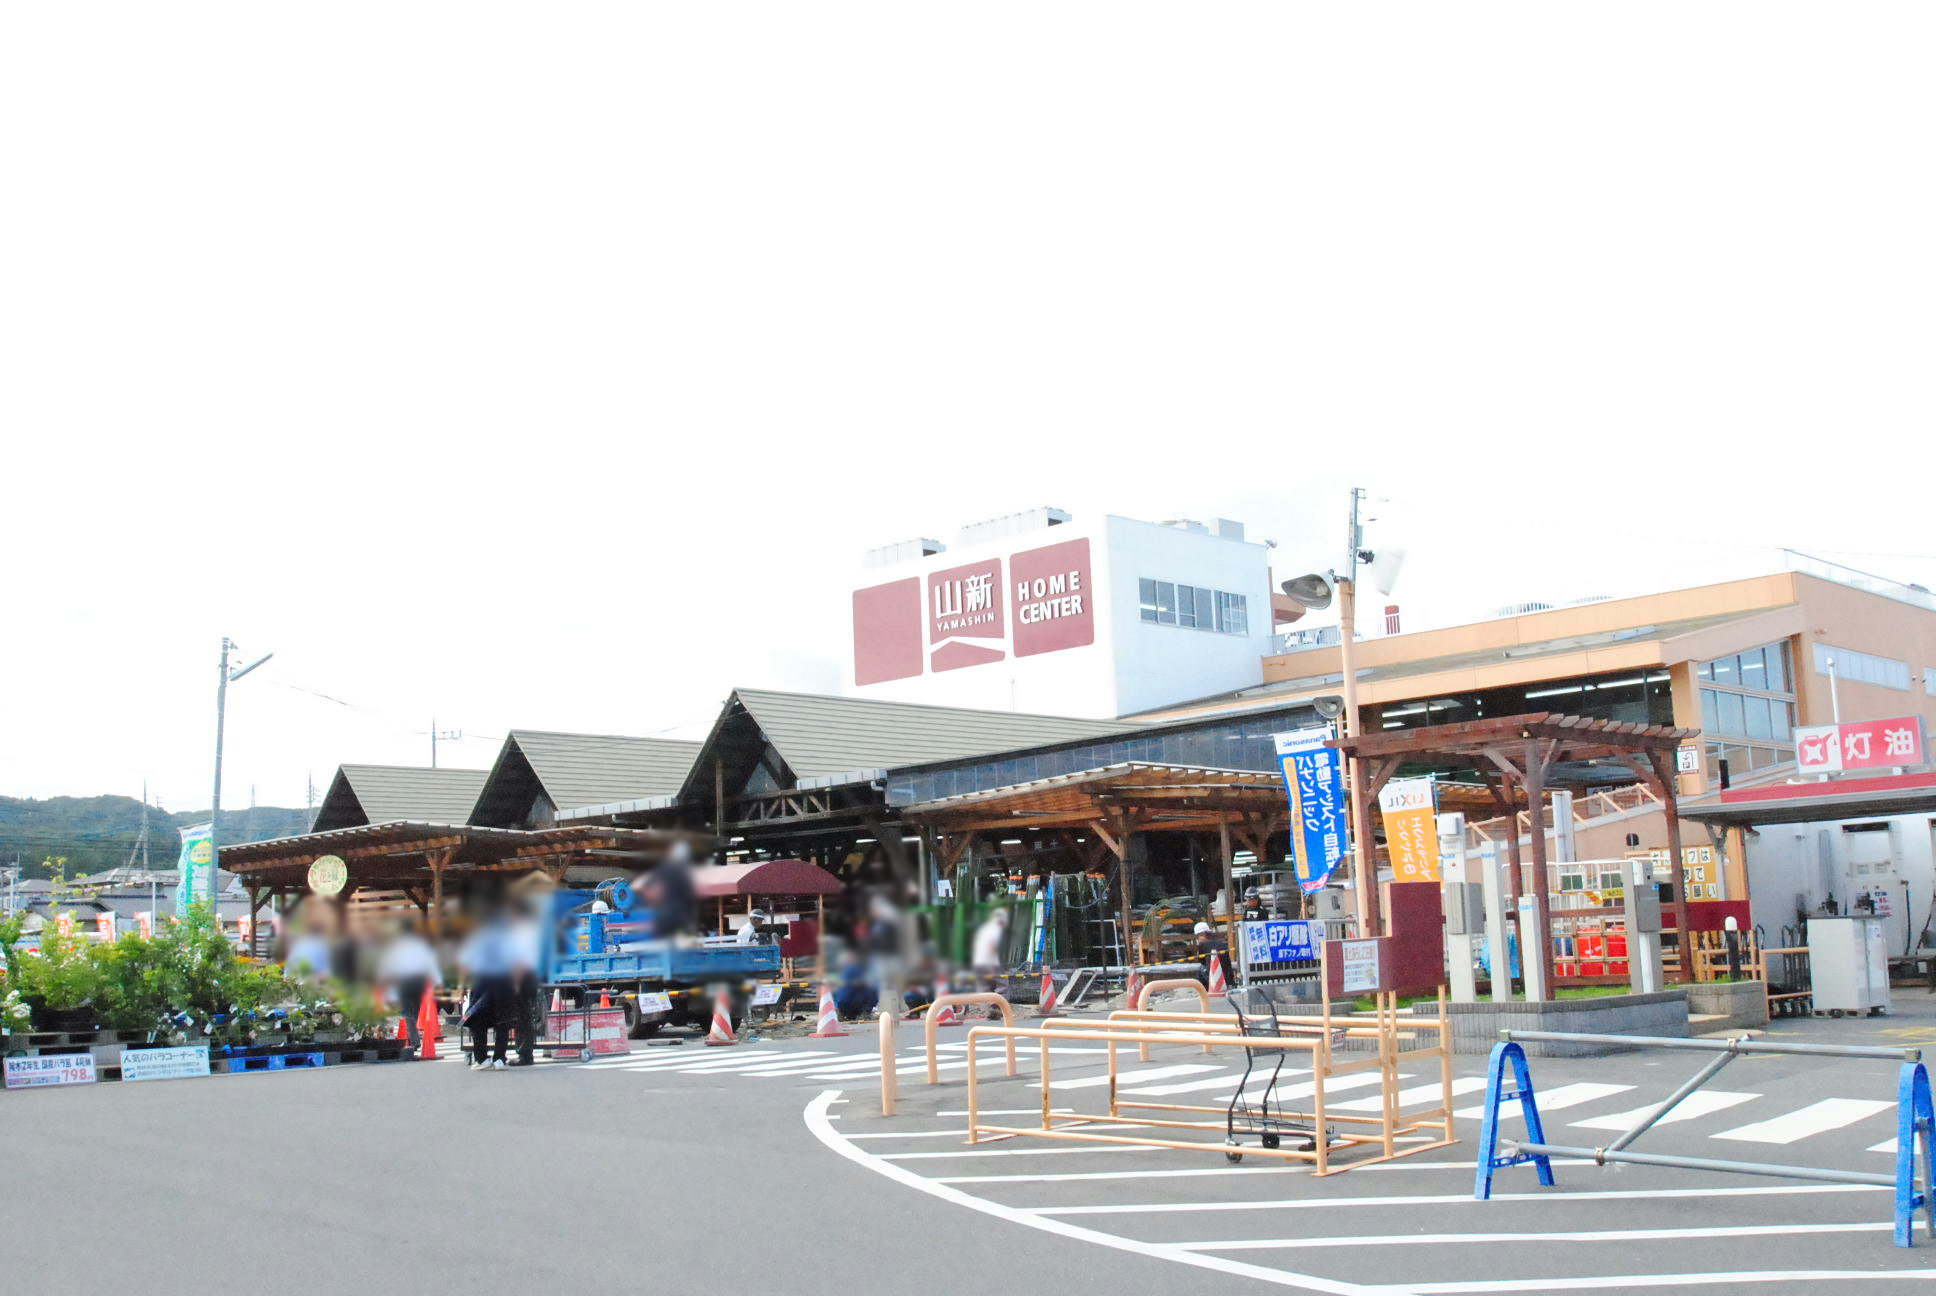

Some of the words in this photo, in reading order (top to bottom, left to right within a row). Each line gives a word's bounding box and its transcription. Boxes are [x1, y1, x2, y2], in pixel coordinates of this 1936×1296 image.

[934, 572, 994, 619] 山新
[1017, 570, 1081, 602] HOME
[936, 612, 996, 632] YAMASHIN
[1019, 594, 1084, 625] CENTER
[1844, 727, 1915, 761] 灯油
